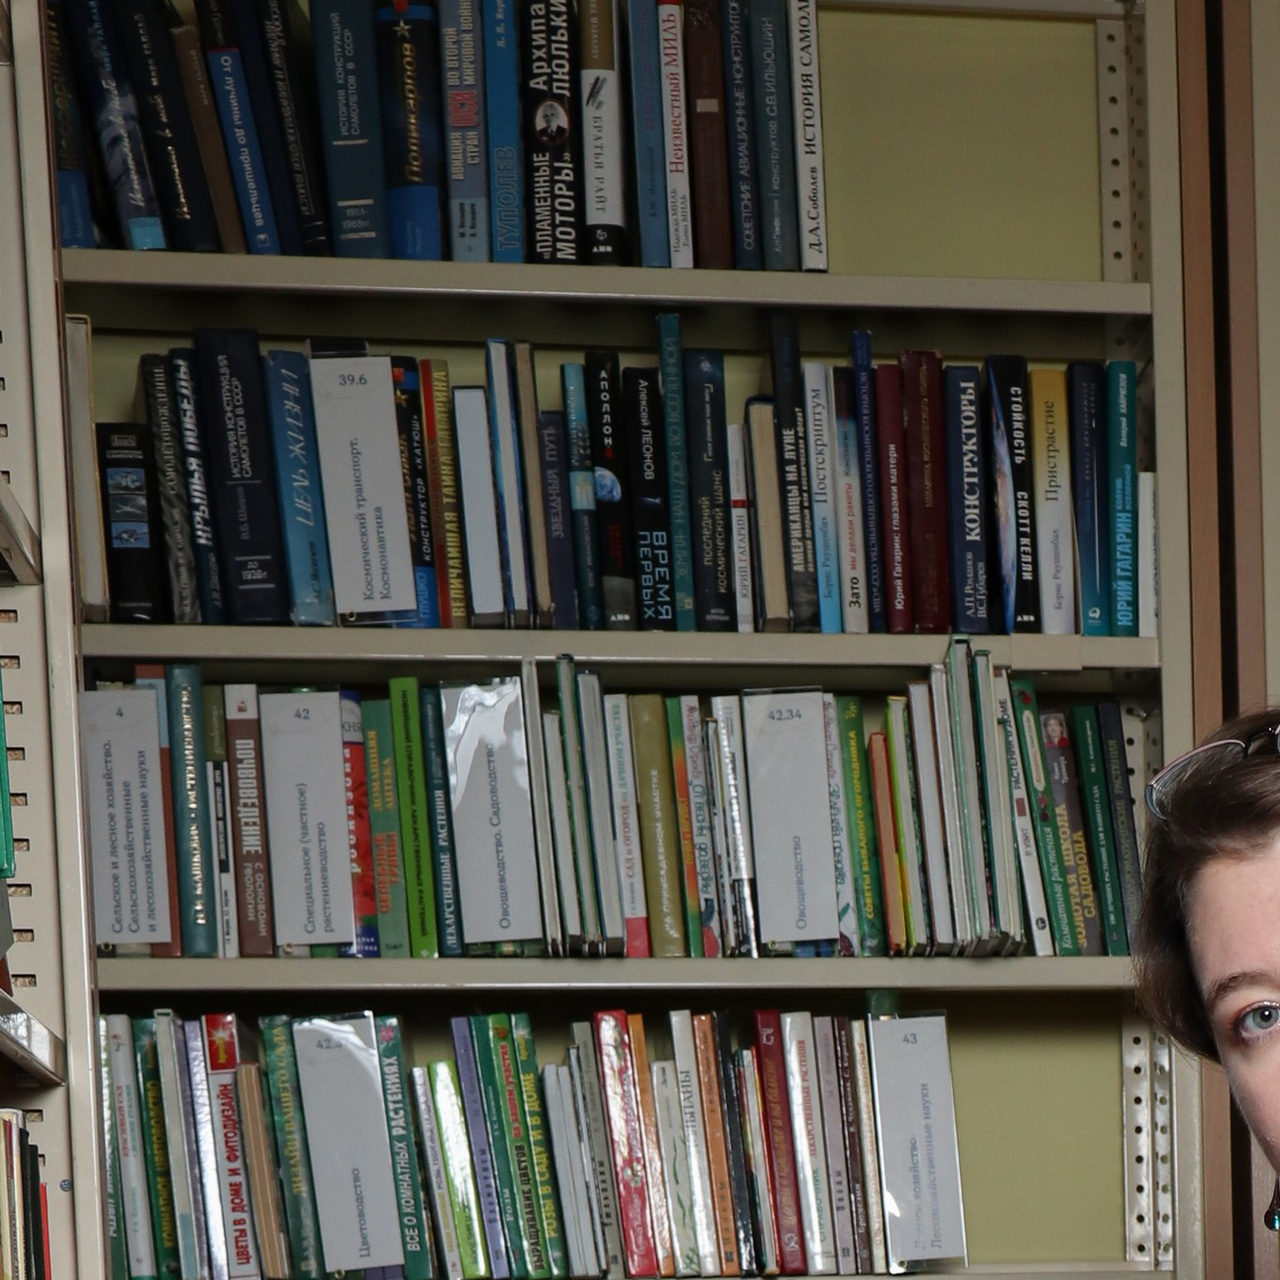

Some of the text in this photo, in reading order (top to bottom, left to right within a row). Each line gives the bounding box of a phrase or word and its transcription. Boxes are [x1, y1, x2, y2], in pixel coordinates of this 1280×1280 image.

[528, 2, 550, 91] Архипа
[397, 41, 423, 182] Поликарпов
[448, 89, 478, 127] ОСИ
[494, 144, 519, 251] ТУПОЛЕВ
[279, 367, 315, 527] ЦЕЛЬ ЖИЗНИ
[808, 387, 829, 505] Постскриптум
[959, 380, 982, 541] КОНСТРУКТОРЫ
[1041, 400, 1061, 502] Пристрастие
[348, 437, 376, 601] Космический транспорт.
[373, 505, 393, 600] Космонавтика
[1112, 511, 1133, 626] ЮРИЙ ГАГАРИН
[638, 530, 657, 619] ПЕРВЫХ
[655, 530, 673, 619] ВРЕМЯ
[236, 740, 262, 854] ПОЧВОВЕДЕНИЕ
[121, 781, 140, 933] Сельскохозяйственные
[793, 836, 807, 930] Овощеводство
[1055, 804, 1087, 947] ЗОЛОТАЯ ШКОЛА
[1074, 830, 1096, 917] САДОВОДА
[903, 1033, 917, 1044] 43
[383, 1056, 406, 1135] РАСТЕНИЯХ
[219, 1084, 251, 1265] ЦВЕТЫ В ДОМЕ И ФИТОДИЗАЙН
[350, 1168, 370, 1258] Цветоводство
[395, 1142, 416, 1213] КОМНАТНЫХ
[515, 1145, 545, 1270] ВЫРАЩИВАНИЕ ЦВЕТОВ
[919, 1084, 942, 1249] Лесохозяйственные науки
[404, 1228, 420, 1251] ВСЕ
